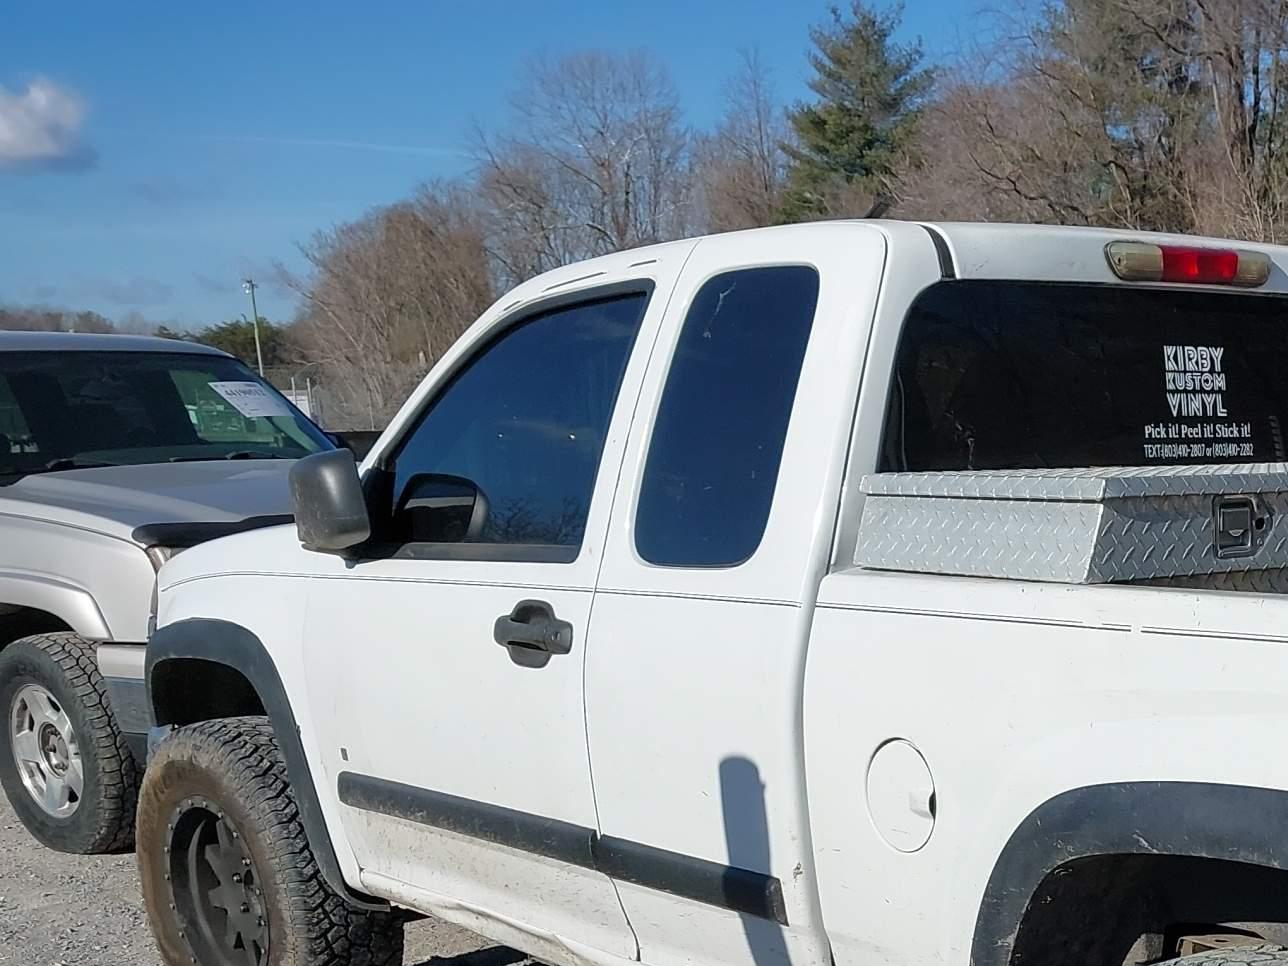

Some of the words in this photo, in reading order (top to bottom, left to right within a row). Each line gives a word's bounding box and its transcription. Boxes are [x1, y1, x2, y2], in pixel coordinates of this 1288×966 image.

[1163, 345, 1224, 372] KIRBY
[1165, 372, 1226, 391] KUSTOM
[1166, 392, 1228, 417] VINYL
[1144, 422, 1167, 438] Pick
[1168, 423, 1179, 438] it!
[1181, 423, 1202, 438] Peel
[1203, 423, 1214, 438] it!
[1215, 422, 1239, 438] Stick
[1241, 422, 1251, 438] it!
[1206, 447, 1213, 456] or
